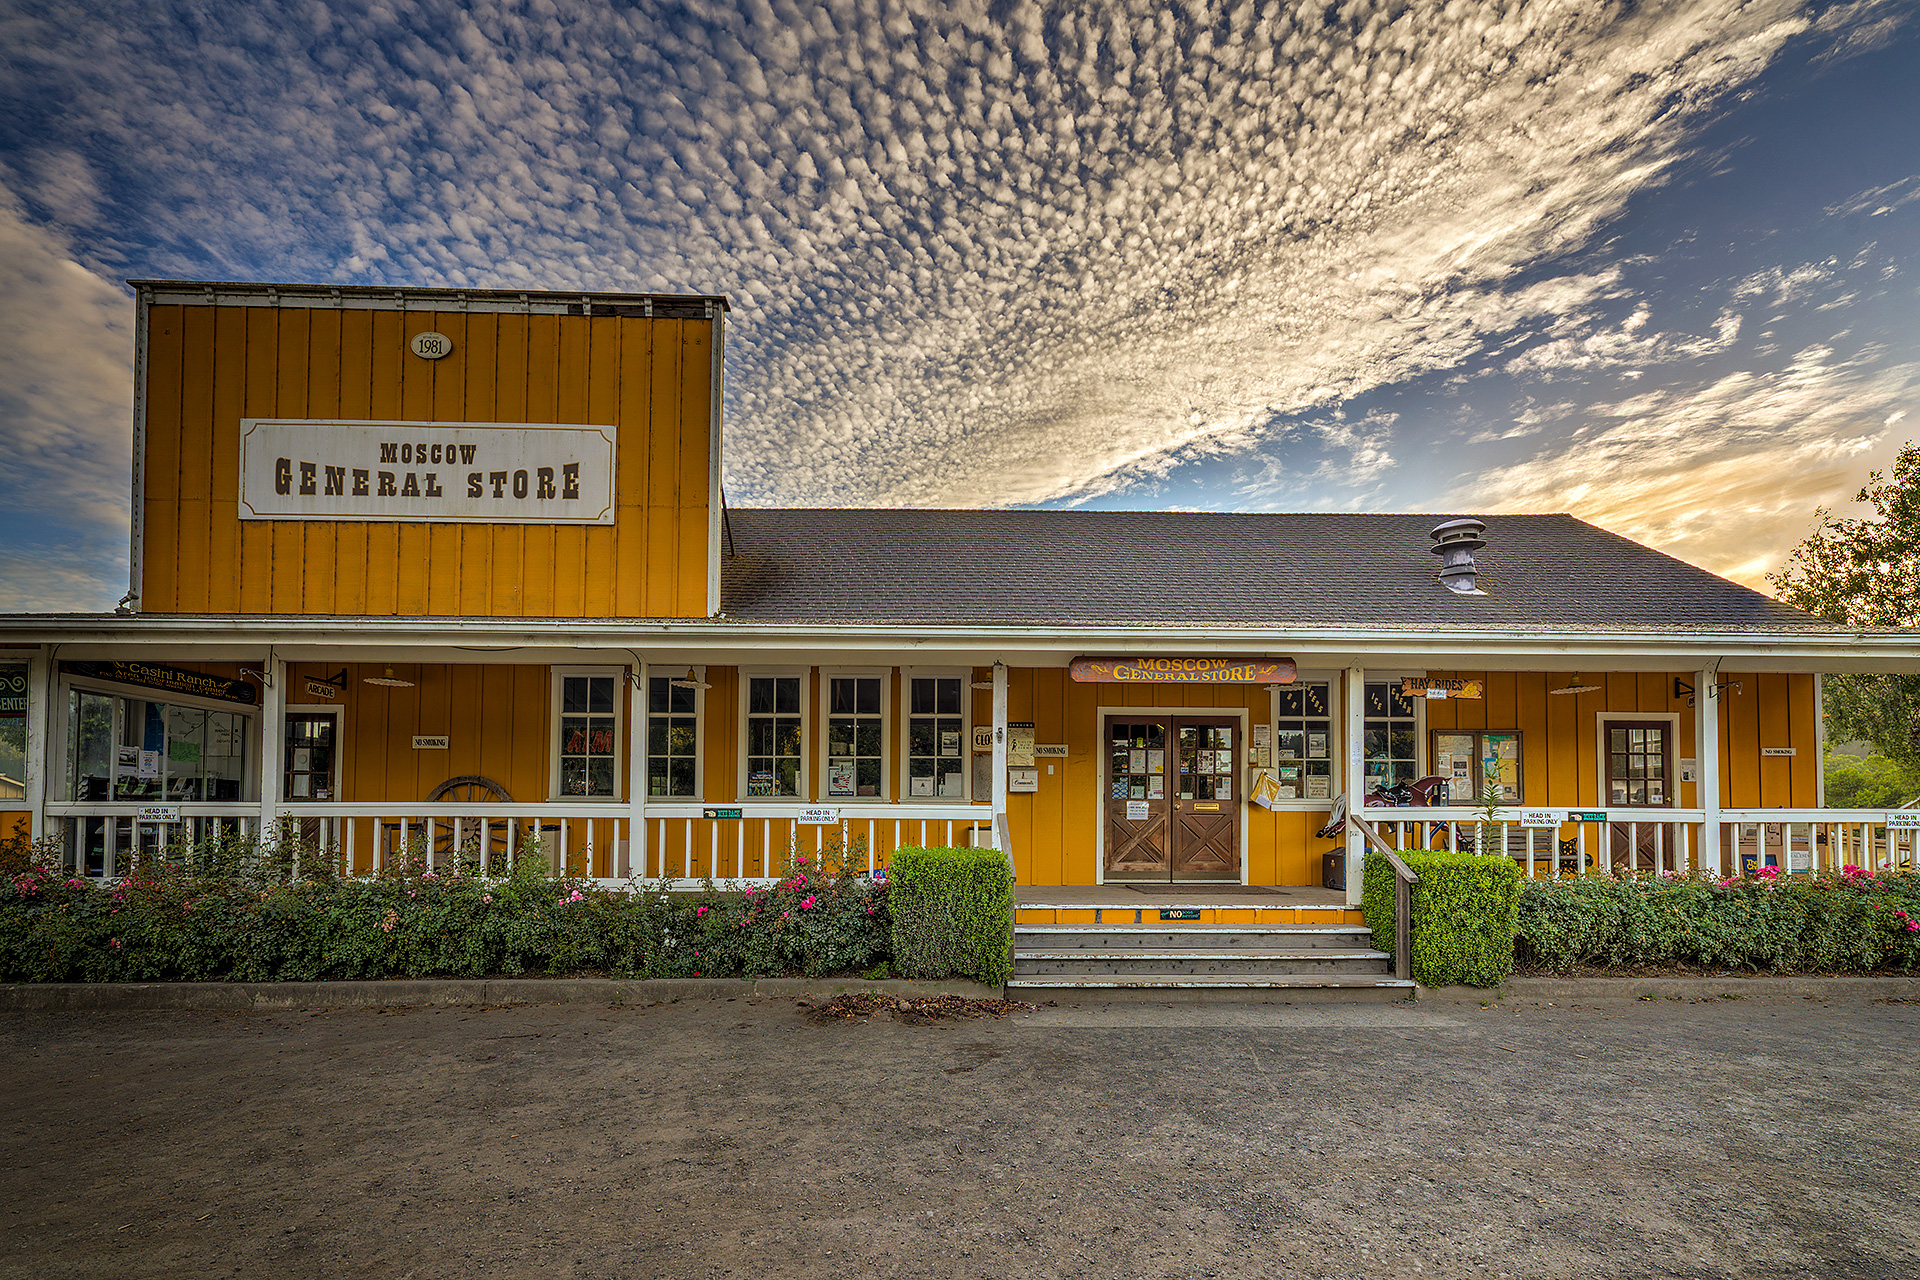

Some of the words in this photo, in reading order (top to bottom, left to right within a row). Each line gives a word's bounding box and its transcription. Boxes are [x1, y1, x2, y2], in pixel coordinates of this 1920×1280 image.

[419, 339, 443, 354] 1981
[379, 442, 477, 465] MOSCOW
[275, 456, 443, 498] GENERAL
[467, 462, 580, 500] STORE
[1137, 658, 1229, 672] MOSCOW
[129, 663, 174, 679] Casini
[176, 671, 217, 688] Ranch
[1112, 664, 1200, 682] GENERAL
[1201, 664, 1257, 682] STORE
[308, 683, 334, 698] ARCADE
[1411, 678, 1432, 690] HAY
[1434, 679, 1463, 691] RIDES
[0, 697, 28, 711] ENTE
[1371, 692, 1383, 711] ICE
[415, 738, 422, 747] NO
[422, 738, 446, 747] SMOKING
[567, 730, 613, 753] ATM
[1035, 746, 1043, 755] NO
[1043, 747, 1066, 755] SMOKING
[1169, 910, 1183, 918] NO
